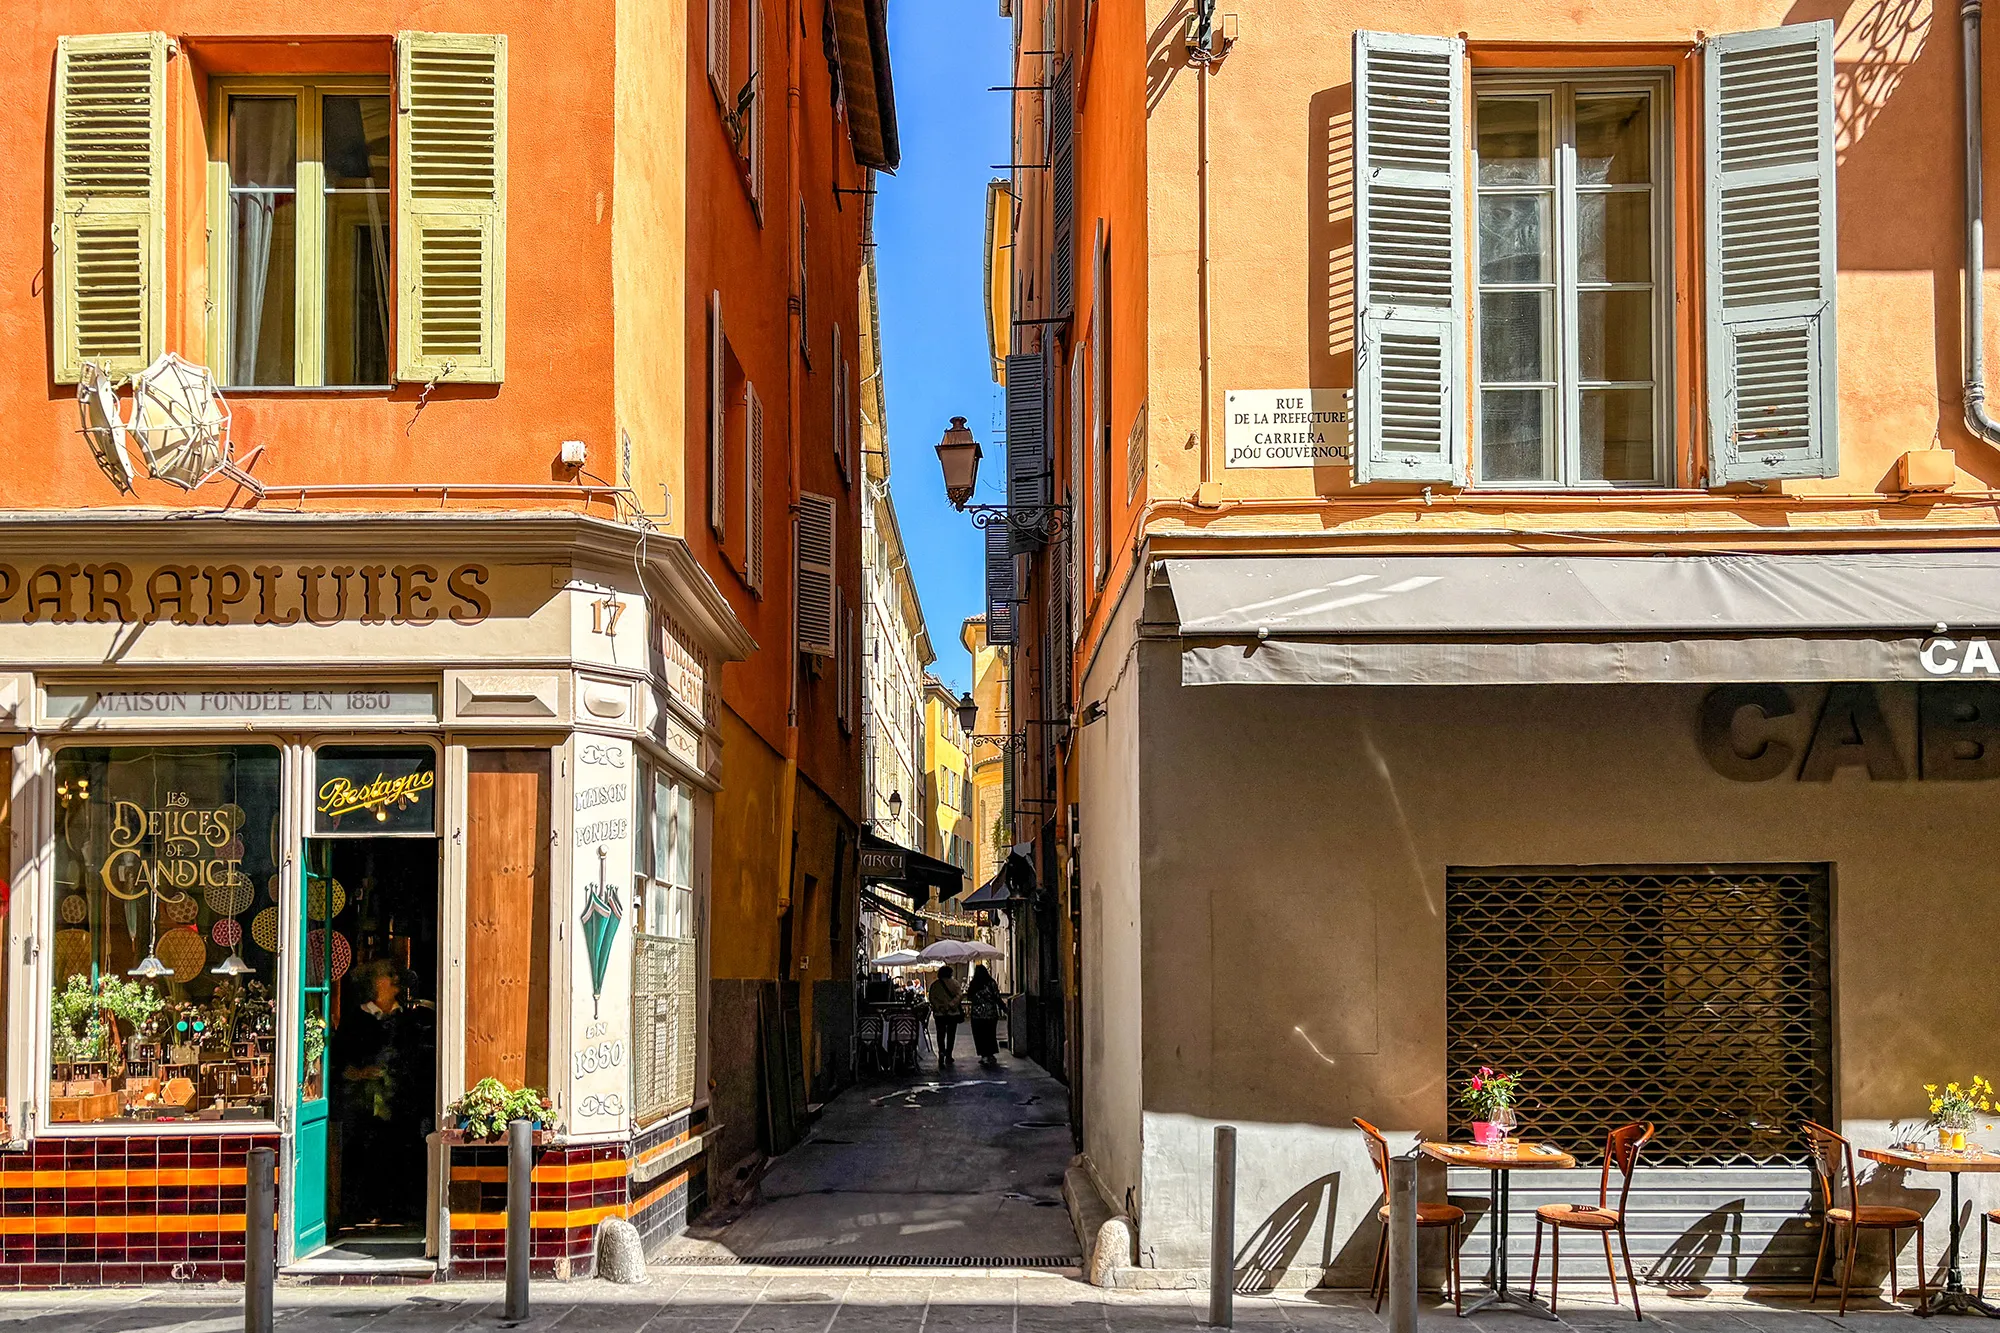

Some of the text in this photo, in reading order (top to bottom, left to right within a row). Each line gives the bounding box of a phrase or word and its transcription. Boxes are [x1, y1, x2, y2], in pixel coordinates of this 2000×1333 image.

[1276, 398, 1304, 409] RUE
[1234, 411, 1346, 425] DE LA PREFECTURE
[1254, 432, 1325, 444] CARRIERA
[1233, 445, 1262, 459] DÓU
[590, 598, 627, 637] 17
[1920, 636, 2000, 675] CA
[96, 687, 391, 711] MAISON FONDÉE EN 1850
[1696, 682, 2000, 783] CAB
[166, 791, 189, 808] LES
[317, 770, 434, 812] Bestagno
[575, 783, 627, 812] MAISON
[110, 801, 230, 857] DELICES
[165, 843, 185, 857] DE
[100, 849, 242, 903] CANDICE
[585, 1021, 608, 1039] EN
[574, 1039, 624, 1080] 1850
